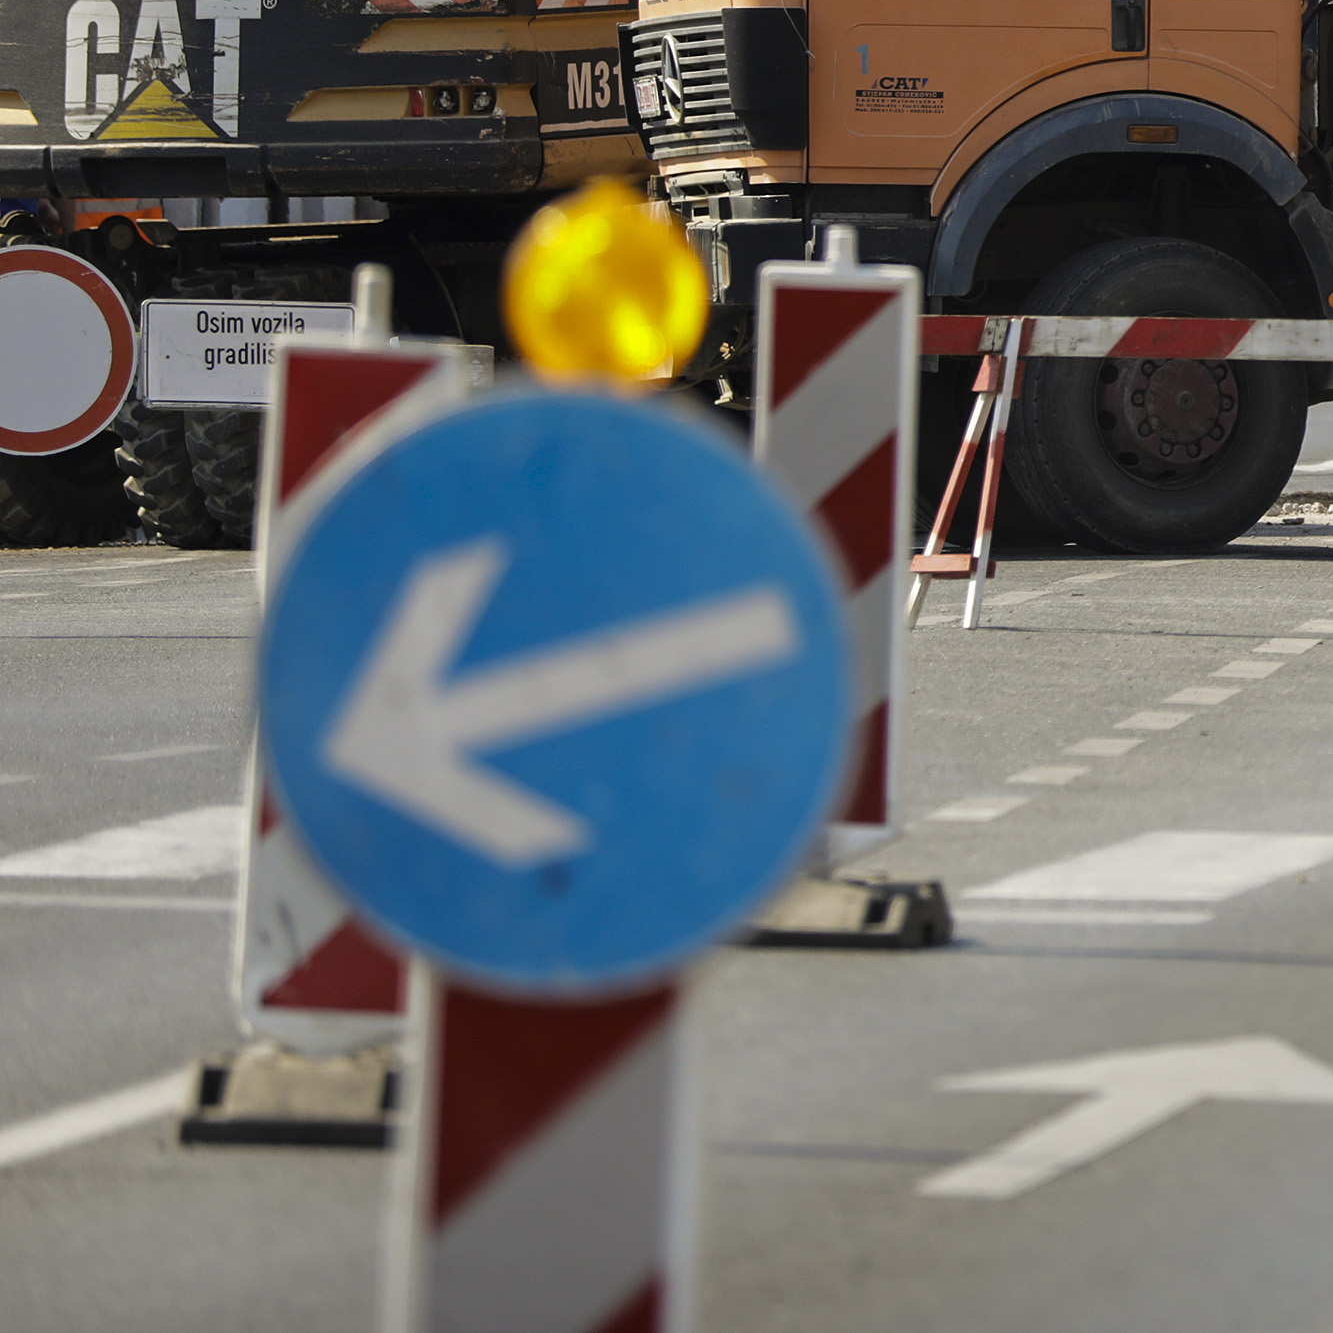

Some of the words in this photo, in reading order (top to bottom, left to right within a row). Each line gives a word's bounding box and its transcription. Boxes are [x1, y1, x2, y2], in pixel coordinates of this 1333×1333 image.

[856, 43, 869, 75] 1
[879, 76, 921, 90] CAT
[196, 310, 244, 334] Osim
[251, 312, 305, 334] vozila
